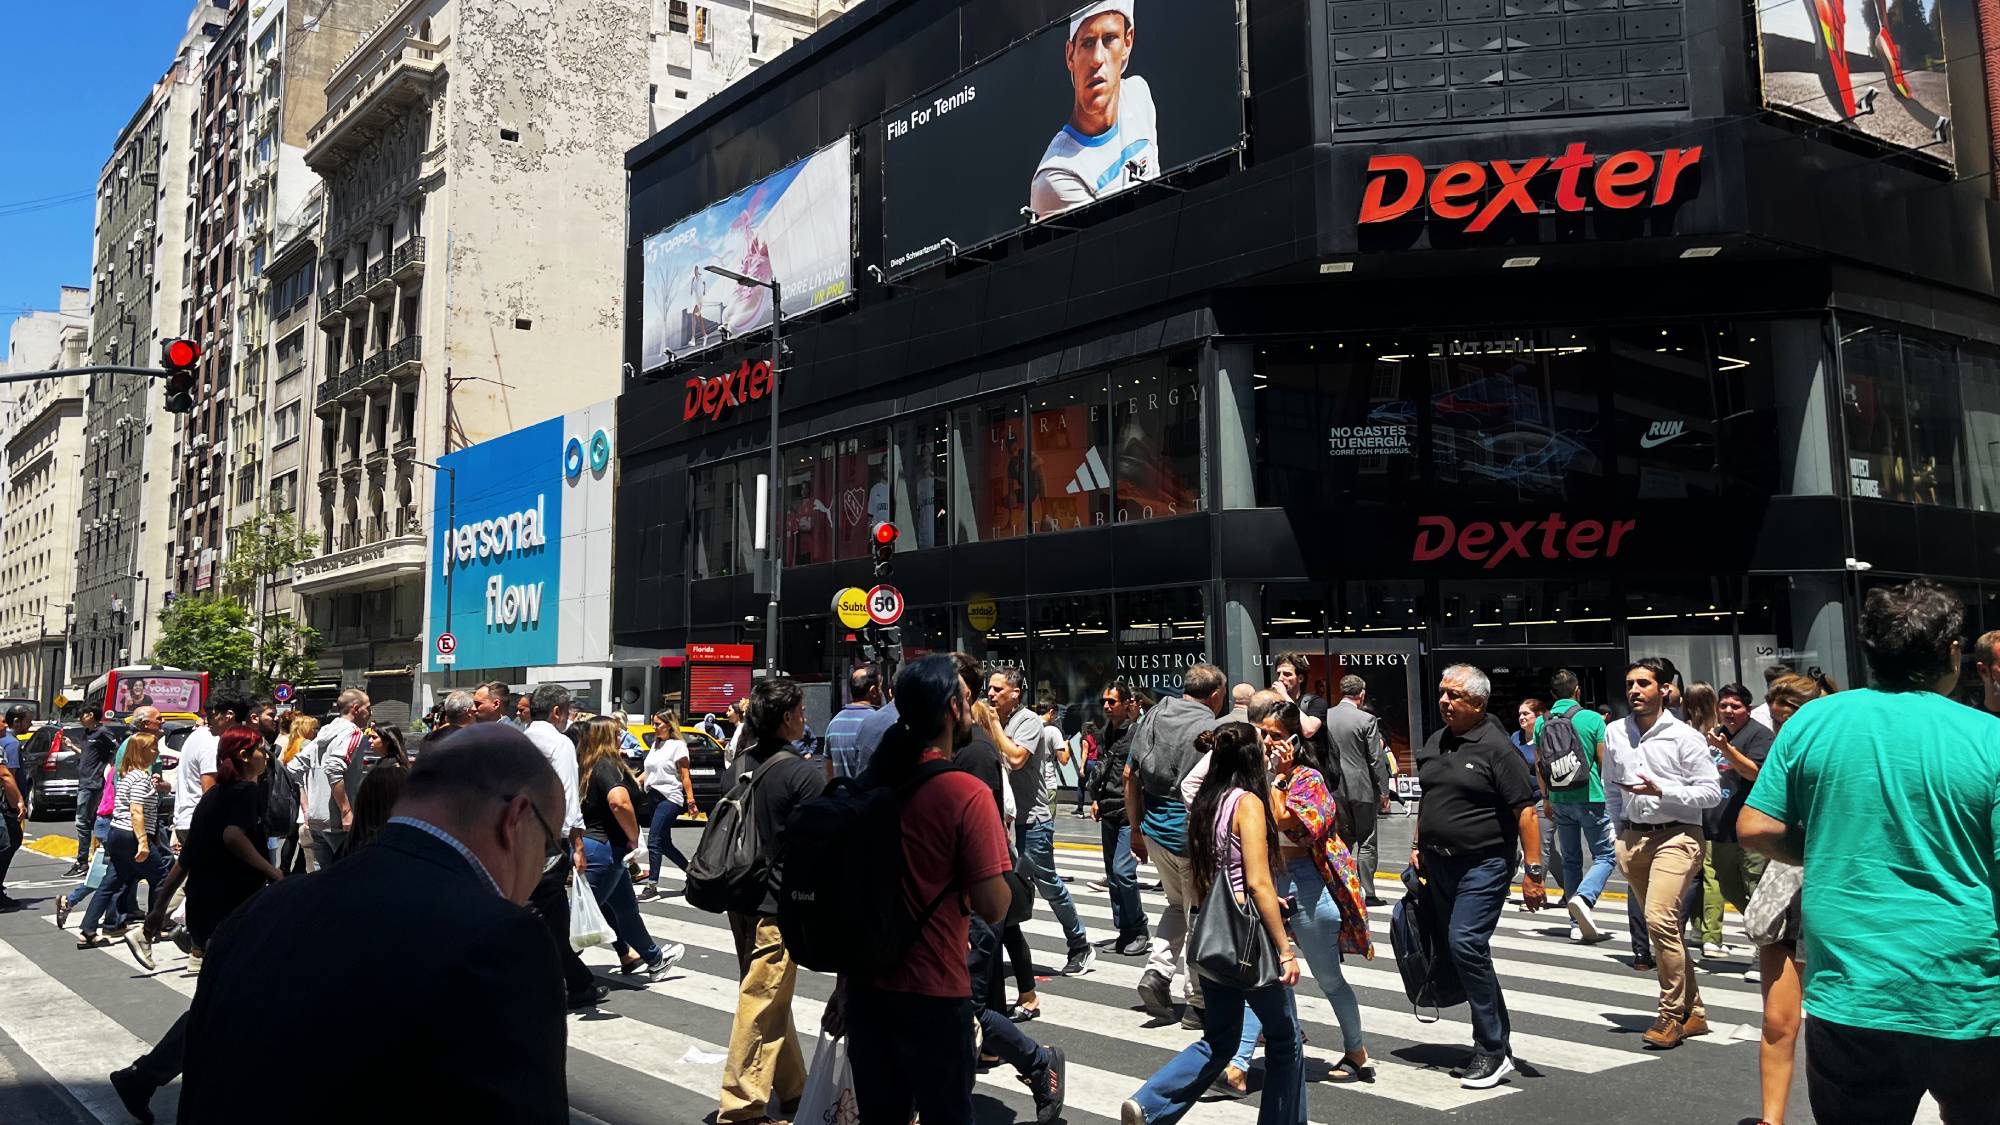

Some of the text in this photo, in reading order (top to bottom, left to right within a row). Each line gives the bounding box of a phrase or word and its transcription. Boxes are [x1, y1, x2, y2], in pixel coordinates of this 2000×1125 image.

[887, 85, 976, 141] Fila For Tennis
[1358, 142, 1703, 233] Dexter
[659, 227, 698, 255] TOPPER
[991, 384, 1201, 443] ULRA EERGY
[1331, 425, 1407, 438] NO GASTES
[1648, 420, 1684, 436] RUN
[1328, 437, 1347, 449] TU
[443, 493, 546, 577] personal
[1413, 512, 1636, 569] Dexter
[486, 574, 545, 626] flow
[874, 596, 895, 612] 50
[692, 645, 714, 653] Florida
[982, 658, 1026, 673] ESTRA
[1117, 652, 1207, 670] NUESTROS
[1339, 653, 1411, 666] ENERGY
[1116, 674, 1182, 689] AMPEO
[1551, 750, 1579, 779] NIKE
